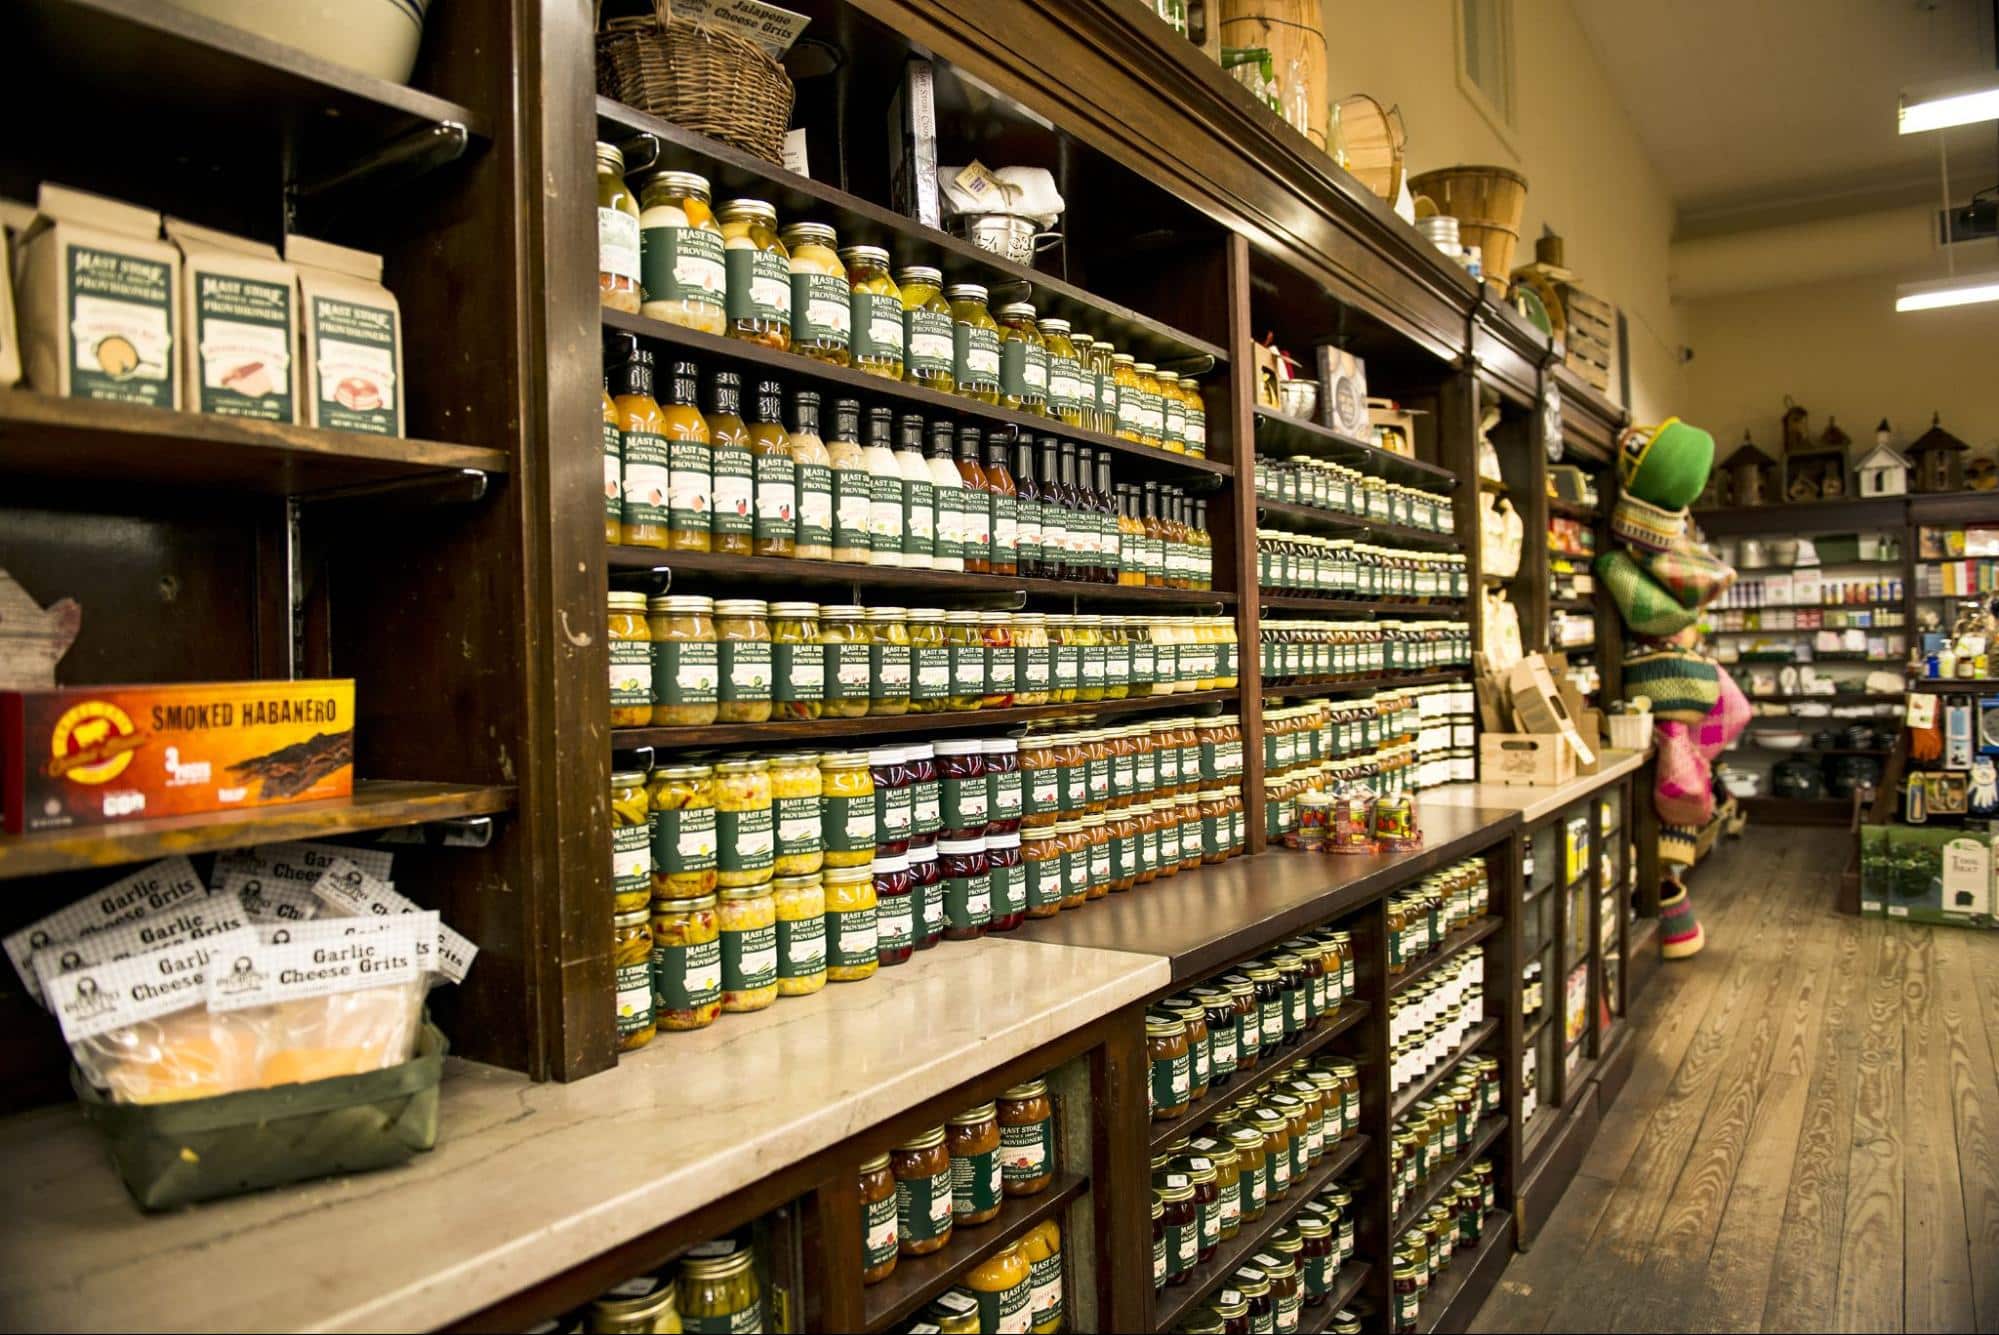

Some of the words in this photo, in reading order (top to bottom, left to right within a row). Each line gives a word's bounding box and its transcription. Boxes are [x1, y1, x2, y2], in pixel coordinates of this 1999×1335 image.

[714, 7, 758, 28] Cheese
[762, 22, 793, 39] Grits
[677, 228, 705, 244] MAST
[753, 251, 777, 267] MAST
[203, 278, 240, 295] MAST
[809, 274, 833, 289] MAST
[872, 295, 894, 308] MAST
[318, 302, 350, 317] MAST
[912, 311, 935, 323] MAST
[969, 328, 989, 340] MAST
[626, 436, 652, 449] MAST
[671, 445, 697, 458] MAST
[714, 451, 739, 463] MAST
[758, 458, 781, 470] MAST
[803, 467, 824, 479] MAST
[841, 472, 861, 484] MAST
[912, 483, 931, 495] MAST
[940, 489, 960, 500] MAST
[680, 643, 703, 655] MAST
[734, 643, 757, 655] MAST
[792, 645, 812, 656] MAST
[840, 645, 858, 655] MAST
[883, 647, 900, 656] MAST
[920, 649, 937, 658] MAST
[958, 648, 974, 657] MAST
[152, 703, 233, 731] SMOKED
[242, 698, 337, 726] HABANERO
[960, 778, 977, 789] MAST
[886, 789, 902, 800] MAST
[780, 797, 802, 809] MAST
[848, 796, 866, 808] MAST
[680, 808, 702, 823] MAST
[738, 810, 760, 824] MAST
[273, 863, 322, 882] Chees
[968, 877, 983, 890] MAST
[101, 878, 160, 916] Garlic
[150, 878, 196, 909] Grits
[841, 911, 861, 923] MAST
[140, 913, 205, 945] Garlic
[791, 919, 811, 931] MAST
[742, 930, 762, 942] MAST
[313, 944, 376, 965] Garlic
[438, 945, 464, 967] rits
[686, 944, 707, 958] MAST
[280, 961, 351, 985] Cheese
[360, 954, 408, 975] Grits
[131, 973, 204, 1002] Cheese
[1021, 1124, 1042, 1134] STORE
[869, 1201, 889, 1216] MAST
[1030, 1258, 1050, 1274] MAST
[1000, 1284, 1021, 1304] MAST
